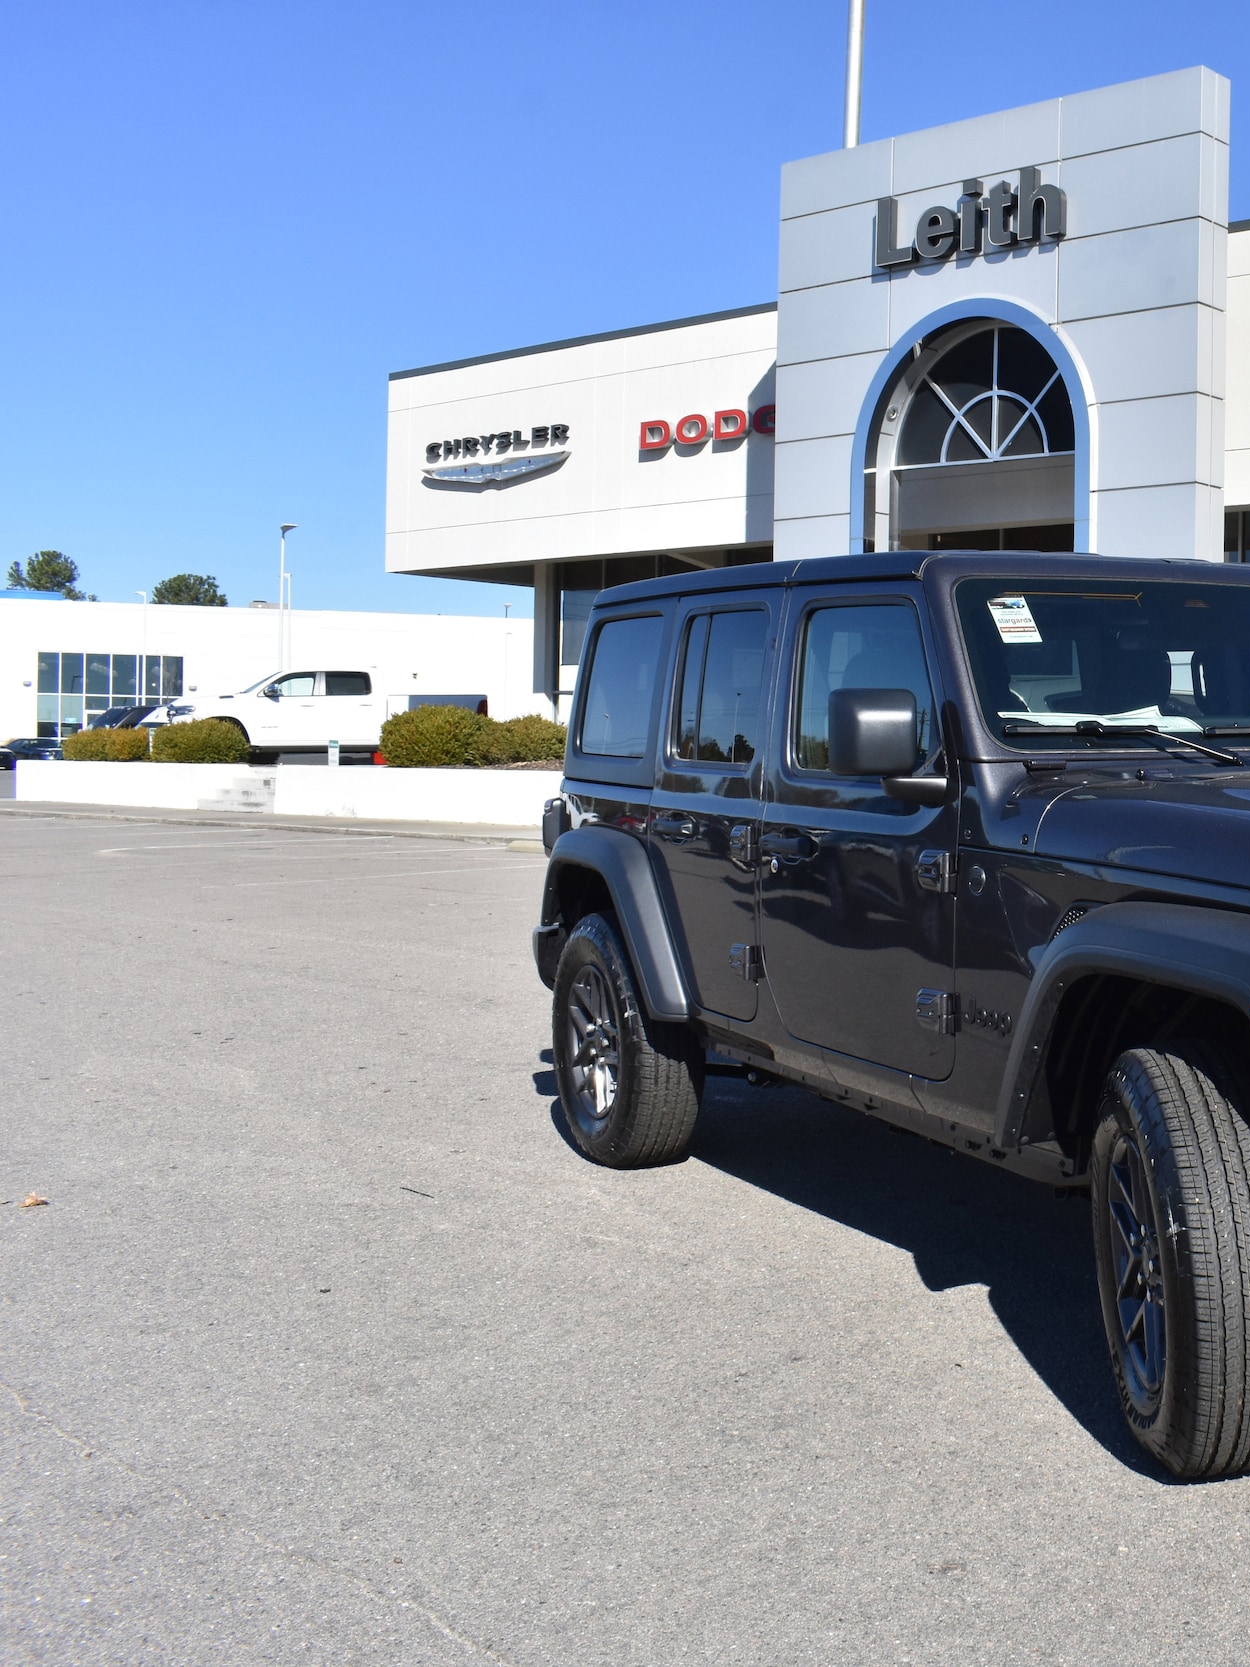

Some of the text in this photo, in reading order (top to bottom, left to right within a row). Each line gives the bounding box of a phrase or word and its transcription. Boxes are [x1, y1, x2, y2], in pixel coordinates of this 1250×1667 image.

[875, 166, 1067, 267] Leith
[425, 423, 571, 460] CHRYSLER
[963, 996, 1013, 1037] Jeep
